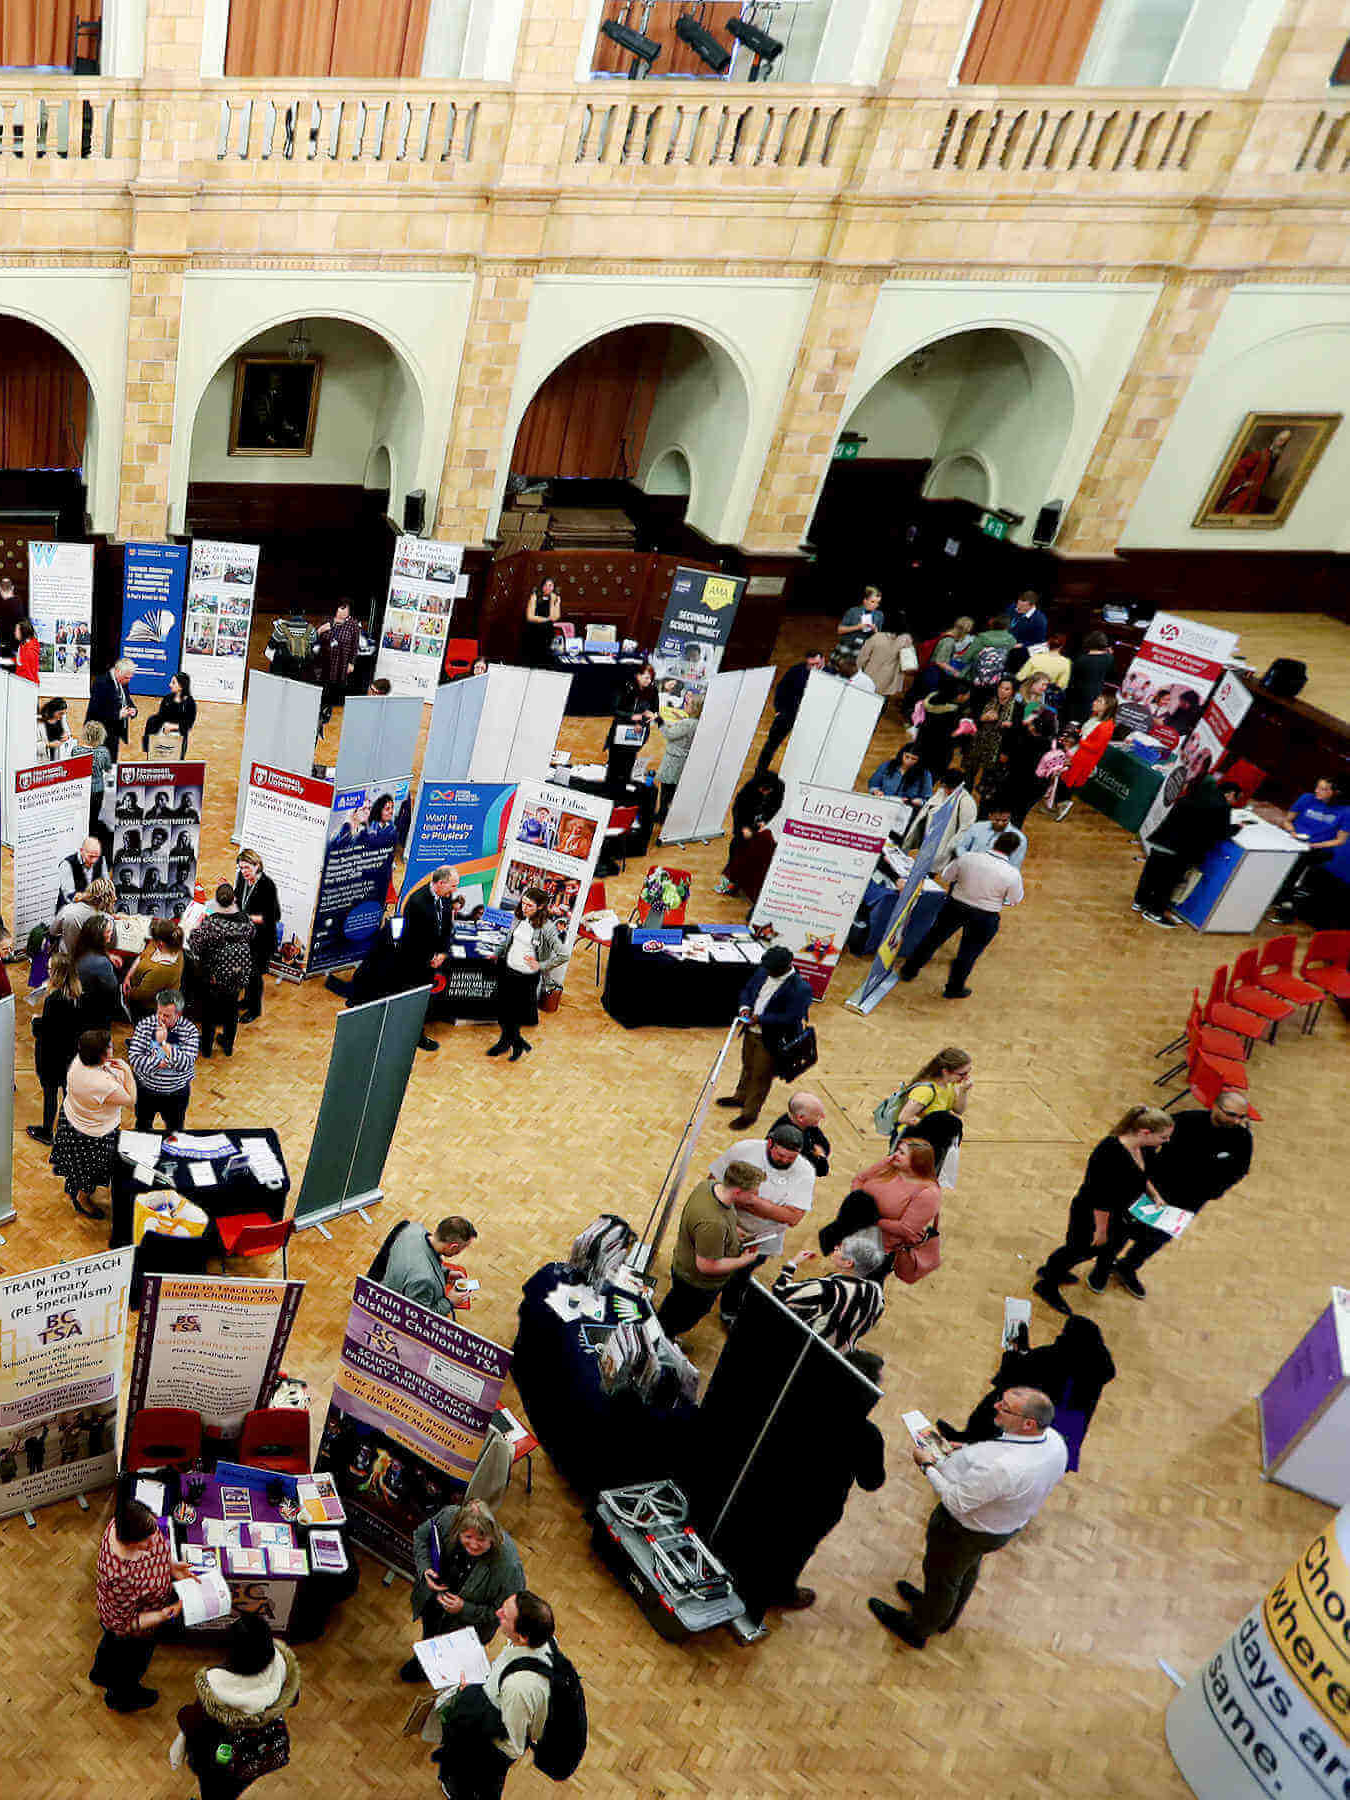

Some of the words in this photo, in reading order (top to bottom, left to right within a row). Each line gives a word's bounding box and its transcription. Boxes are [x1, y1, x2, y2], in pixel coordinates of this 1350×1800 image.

[431, 831, 470, 841] Physics?
[801, 796, 883, 828] Lindens
[2, 1276, 47, 1297] TRAIN
[51, 1270, 71, 1283] TO
[74, 1257, 122, 1277] TEACH
[10, 1304, 32, 1320] (PE
[35, 1284, 114, 1312] Specialism)
[36, 1280, 90, 1300] Primary
[37, 1323, 83, 1346] TSA
[46, 1308, 77, 1329] BC
[169, 1322, 203, 1333] TSA
[357, 1295, 401, 1324] Bishop
[405, 1318, 472, 1360] Challoner
[473, 1353, 502, 1376] TSA
[367, 1286, 401, 1311] Train
[405, 1306, 419, 1319] to
[422, 1314, 464, 1343] Teach
[467, 1338, 498, 1361] with
[345, 1349, 391, 1379] PRIMARY
[391, 1374, 417, 1392] AND
[417, 1388, 484, 1429] SECONDARY
[357, 1346, 401, 1375] SCHOOL
[403, 1370, 445, 1399] DIRECT
[343, 1370, 368, 1387] Over
[425, 1416, 475, 1447] available
[366, 1393, 383, 1405] the
[385, 1402, 410, 1421] West
[411, 1418, 457, 1450] Midlands
[1238, 1617, 1293, 1719] days
[1271, 1576, 1350, 1716] where
[1207, 1653, 1283, 1792] same.
